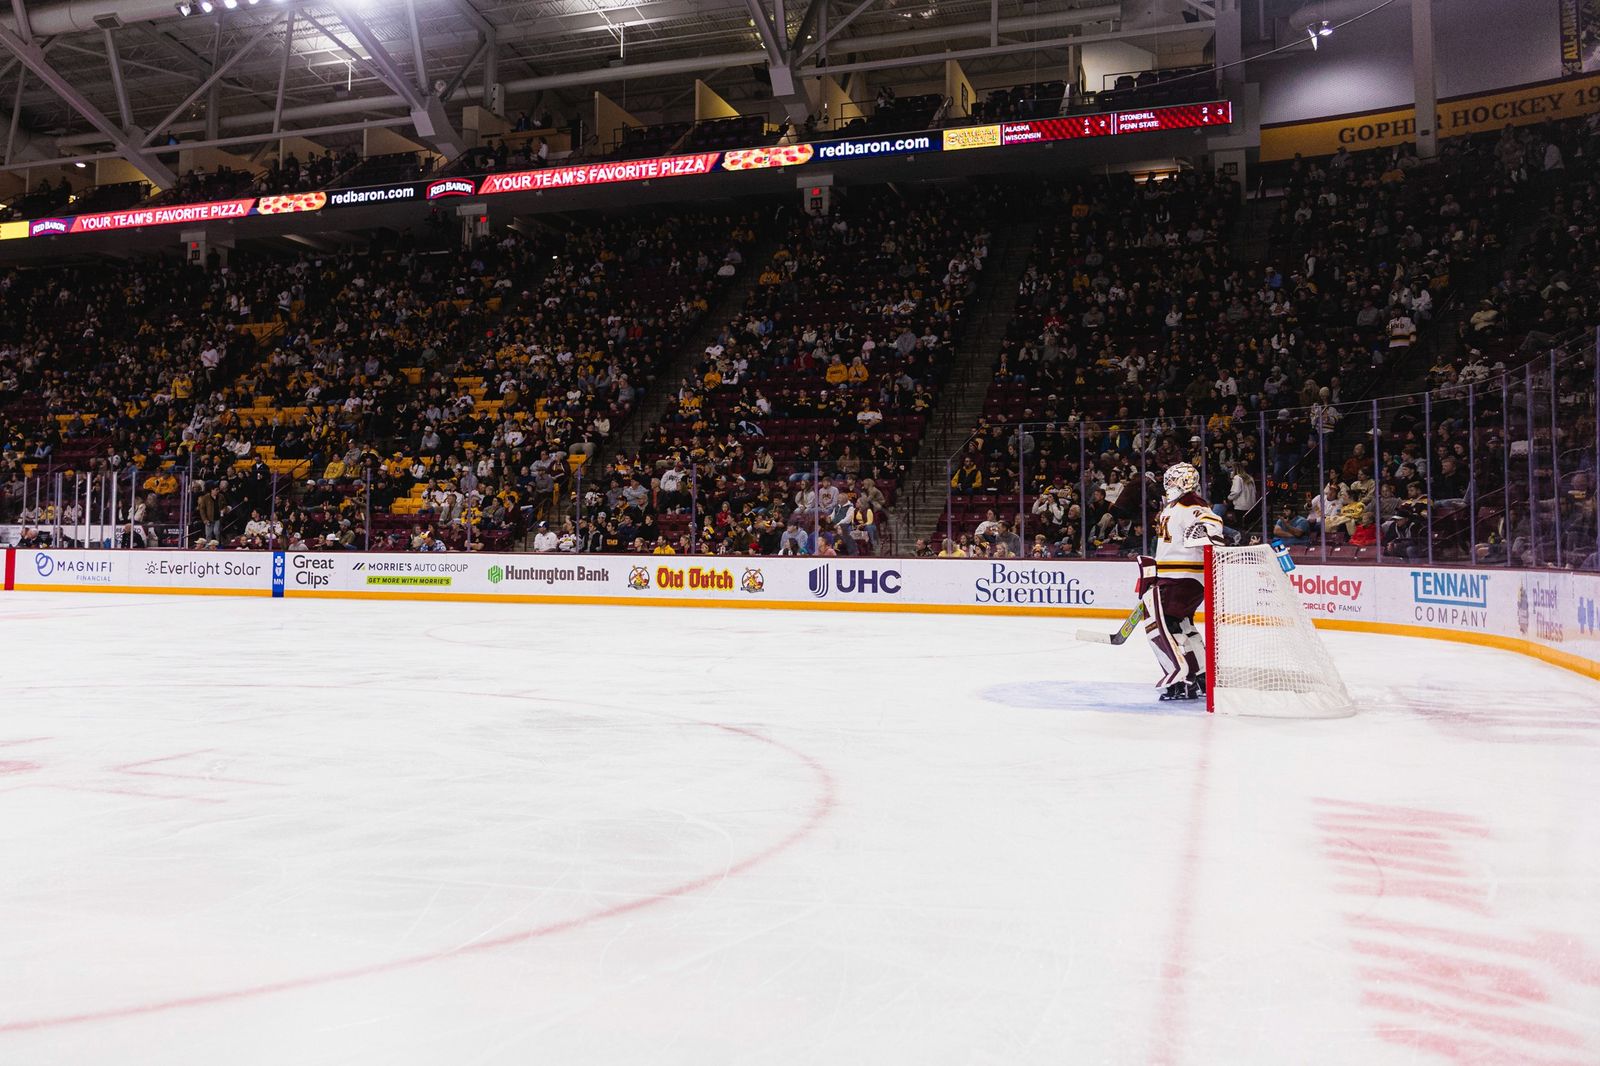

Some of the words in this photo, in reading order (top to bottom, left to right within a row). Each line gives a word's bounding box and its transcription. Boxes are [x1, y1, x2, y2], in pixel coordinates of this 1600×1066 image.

[1119, 112, 1155, 122] STONEHILL
[1201, 106, 1208, 114] 2
[1217, 108, 1224, 116] 3
[1338, 113, 1442, 144] GOPH
[1452, 92, 1566, 128] HOCKEY
[1099, 120, 1106, 128] 2
[1119, 122, 1139, 131] PENN
[1140, 120, 1159, 129] STATE
[1202, 115, 1209, 123] 4
[1005, 124, 1030, 134] ALASKA
[1005, 132, 1042, 142] WISCONSIN
[819, 135, 930, 158] redbaron.com
[493, 174, 532, 191] YOUR
[534, 169, 586, 188] TEAM'S
[588, 162, 657, 183] FAVORITE
[660, 157, 705, 176] PIZZA
[331, 185, 414, 205] redbaron.com
[430, 183, 445, 197] RED
[445, 180, 473, 195] BARON
[81, 214, 111, 230] YOUR
[112, 209, 154, 227] TEAM'S
[155, 205, 209, 225] FAVORITE
[210, 202, 244, 219] PIZZA
[33, 223, 45, 235] RED
[45, 221, 66, 232] BARON
[57, 561, 112, 573] MAGNIFI
[160, 561, 220, 578] Everlight
[222, 562, 261, 576] Solar
[293, 555, 334, 571] Great
[369, 562, 412, 572] MORRIE'S
[414, 563, 437, 573] AUTO
[438, 563, 469, 573] GROUP
[295, 571, 329, 589] Clips
[419, 577, 450, 585] MORRIE'S
[505, 565, 575, 585] Huntington
[577, 566, 609, 582] Bank
[656, 567, 684, 588] Old
[688, 567, 735, 590] Dutch
[836, 569, 902, 594] UHC
[991, 562, 1066, 584] Boston
[273, 578, 283, 586] MN
[975, 576, 1095, 605] Scientific
[1289, 573, 1363, 601] Holiday
[1410, 571, 1489, 602] TENNANT
[1532, 580, 1559, 614] planet
[1338, 604, 1363, 613] FAMILY
[1414, 605, 1489, 628] COMPANY
[1536, 614, 1565, 642] fitness
